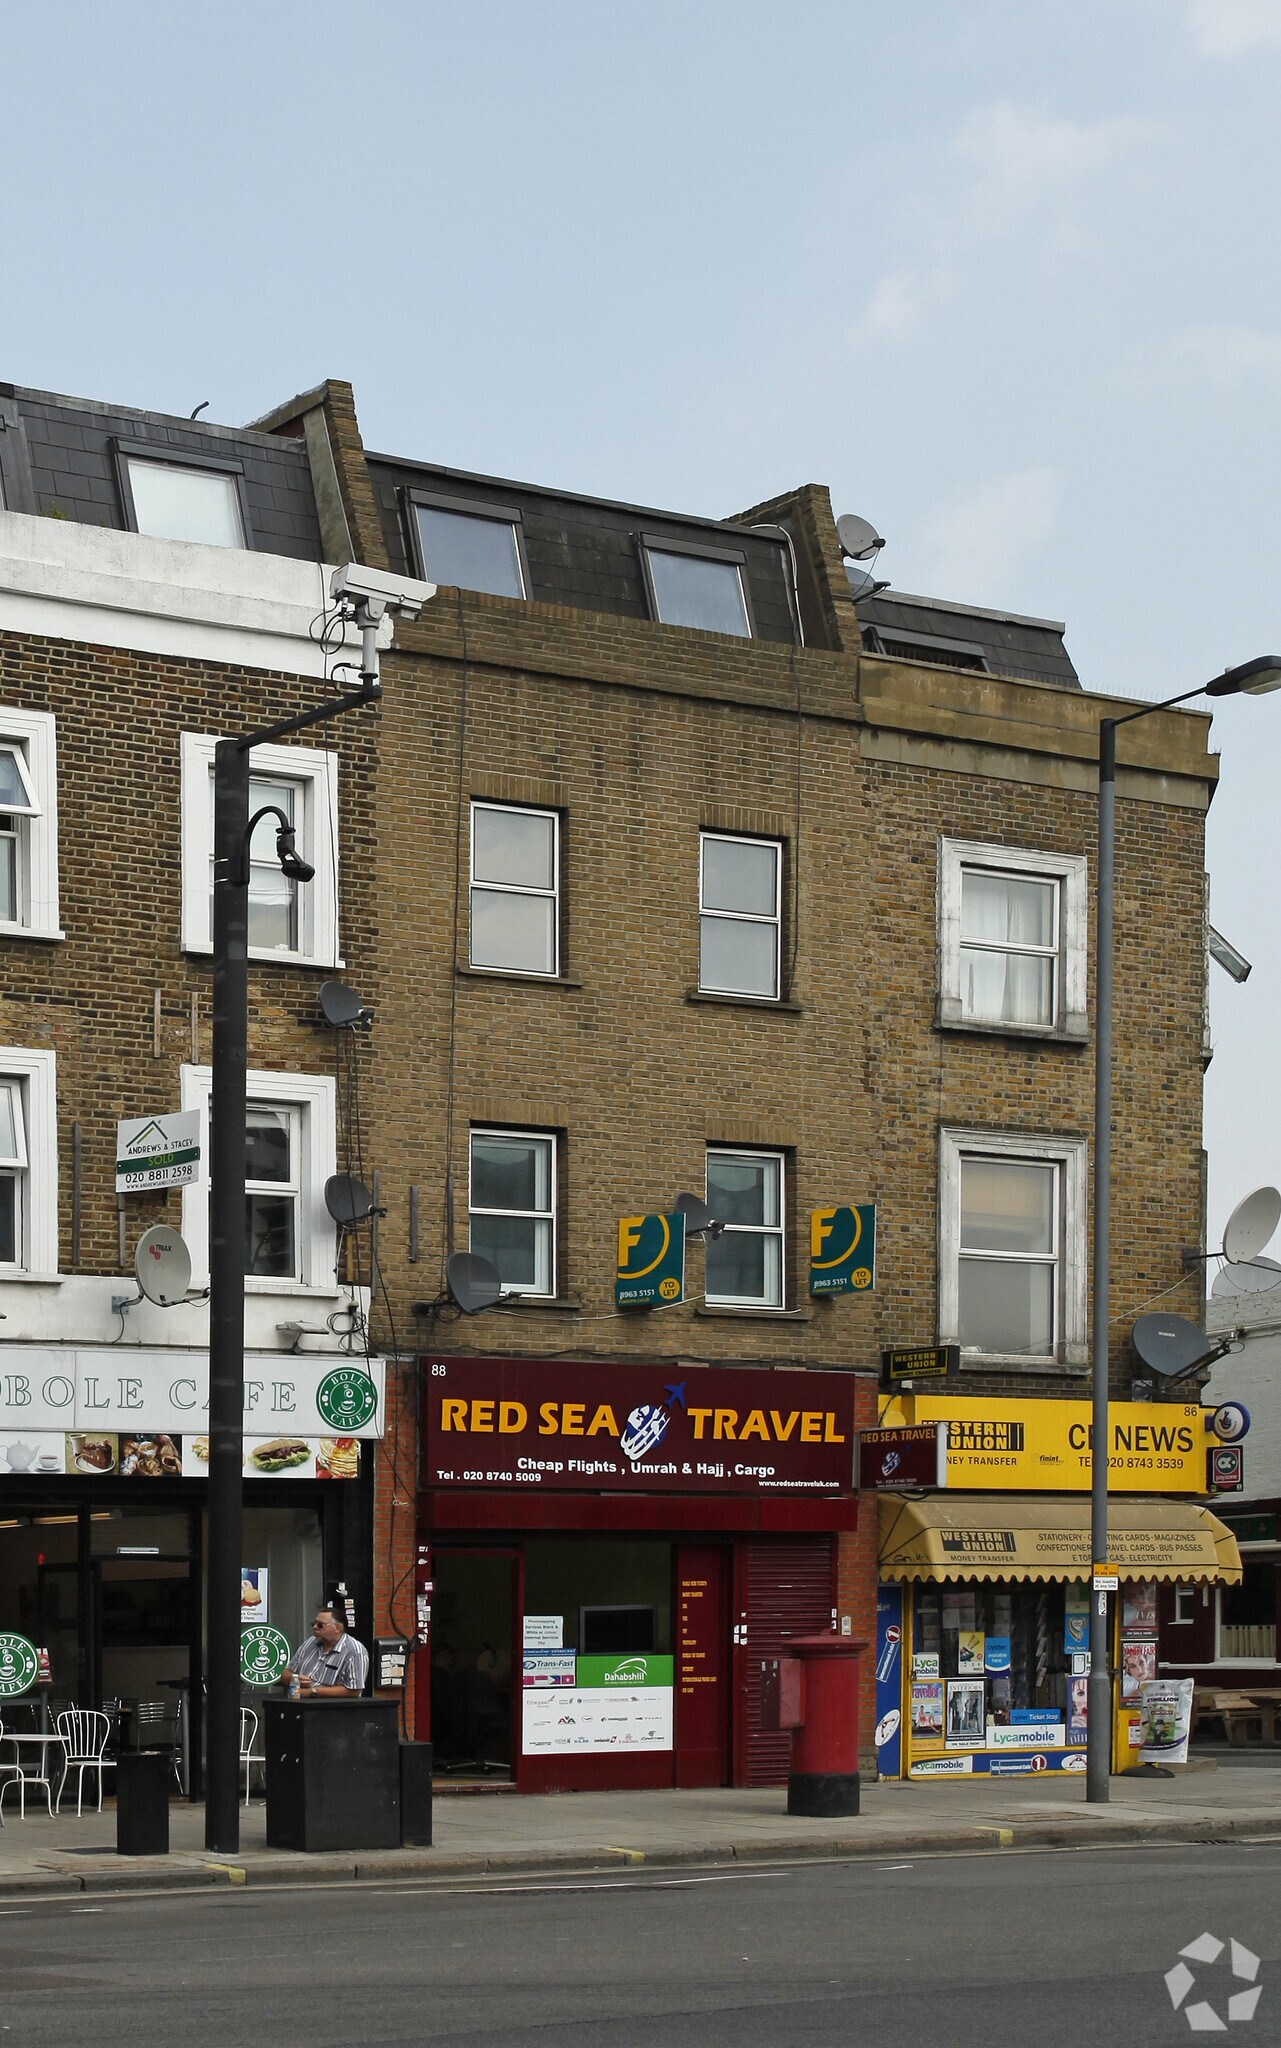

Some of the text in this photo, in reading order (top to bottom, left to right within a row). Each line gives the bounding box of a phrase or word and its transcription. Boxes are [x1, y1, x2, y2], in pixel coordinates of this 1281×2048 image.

[128, 1143, 161, 1155] ANDREWS
[171, 1138, 193, 1149] STACEY
[148, 1153, 174, 1166] SOLD
[125, 1165, 193, 1183] 020 8811 2598
[155, 1244, 172, 1252] TRIAX
[832, 1278, 848, 1286] 5151
[619, 1289, 655, 1299] 8963 5151
[663, 1289, 676, 1297] LET
[894, 1352, 937, 1363] WESTERN
[907, 1360, 936, 1369] UNION
[431, 1364, 447, 1377] 88
[330, 1373, 366, 1387] BOLE
[5, 1375, 297, 1412] BOLE CFE
[1184, 1406, 1198, 1416] 86
[330, 1413, 365, 1426] CAFE
[441, 1399, 846, 1443] RED SEA TRAVEL
[861, 1429, 936, 1443] RED SEA TRAVEL
[1068, 1424, 1093, 1451] C
[1115, 1425, 1194, 1453] NEWS
[950, 1436, 1007, 1450] UNION
[946, 1456, 1017, 1466] NEY TRANSFER
[1078, 1456, 1184, 1469] TE 20 8743 3539
[517, 1457, 776, 1478] Cheap Flights Umrah & Hajj Cargo
[437, 1471, 542, 1482] Tel 020 8740 5009
[759, 1480, 840, 1489] www.redseatraveluk.com
[941, 1531, 1003, 1542] WESTERN
[1038, 1533, 1196, 1542] STATIONERY GTING CARDS MAGAZINES
[962, 1541, 1005, 1551] UNION
[1036, 1544, 1203, 1552] CONFECTIONER RAVEL CARDS BUS PASSES
[1109, 1554, 1125, 1562] GAS
[1129, 1554, 1173, 1562] ELECTRICITY
[246, 1629, 282, 1645] BOLE
[537, 1660, 574, 1668] Trans-Fast
[914, 1657, 938, 1669] Lyca
[243, 1668, 278, 1683] CAFE
[604, 1672, 645, 1681] Dahabshiil
[914, 1667, 938, 1675] mobile
[993, 1731, 1055, 1745] Lycamobile
[915, 1760, 964, 1771] Lycamobile
